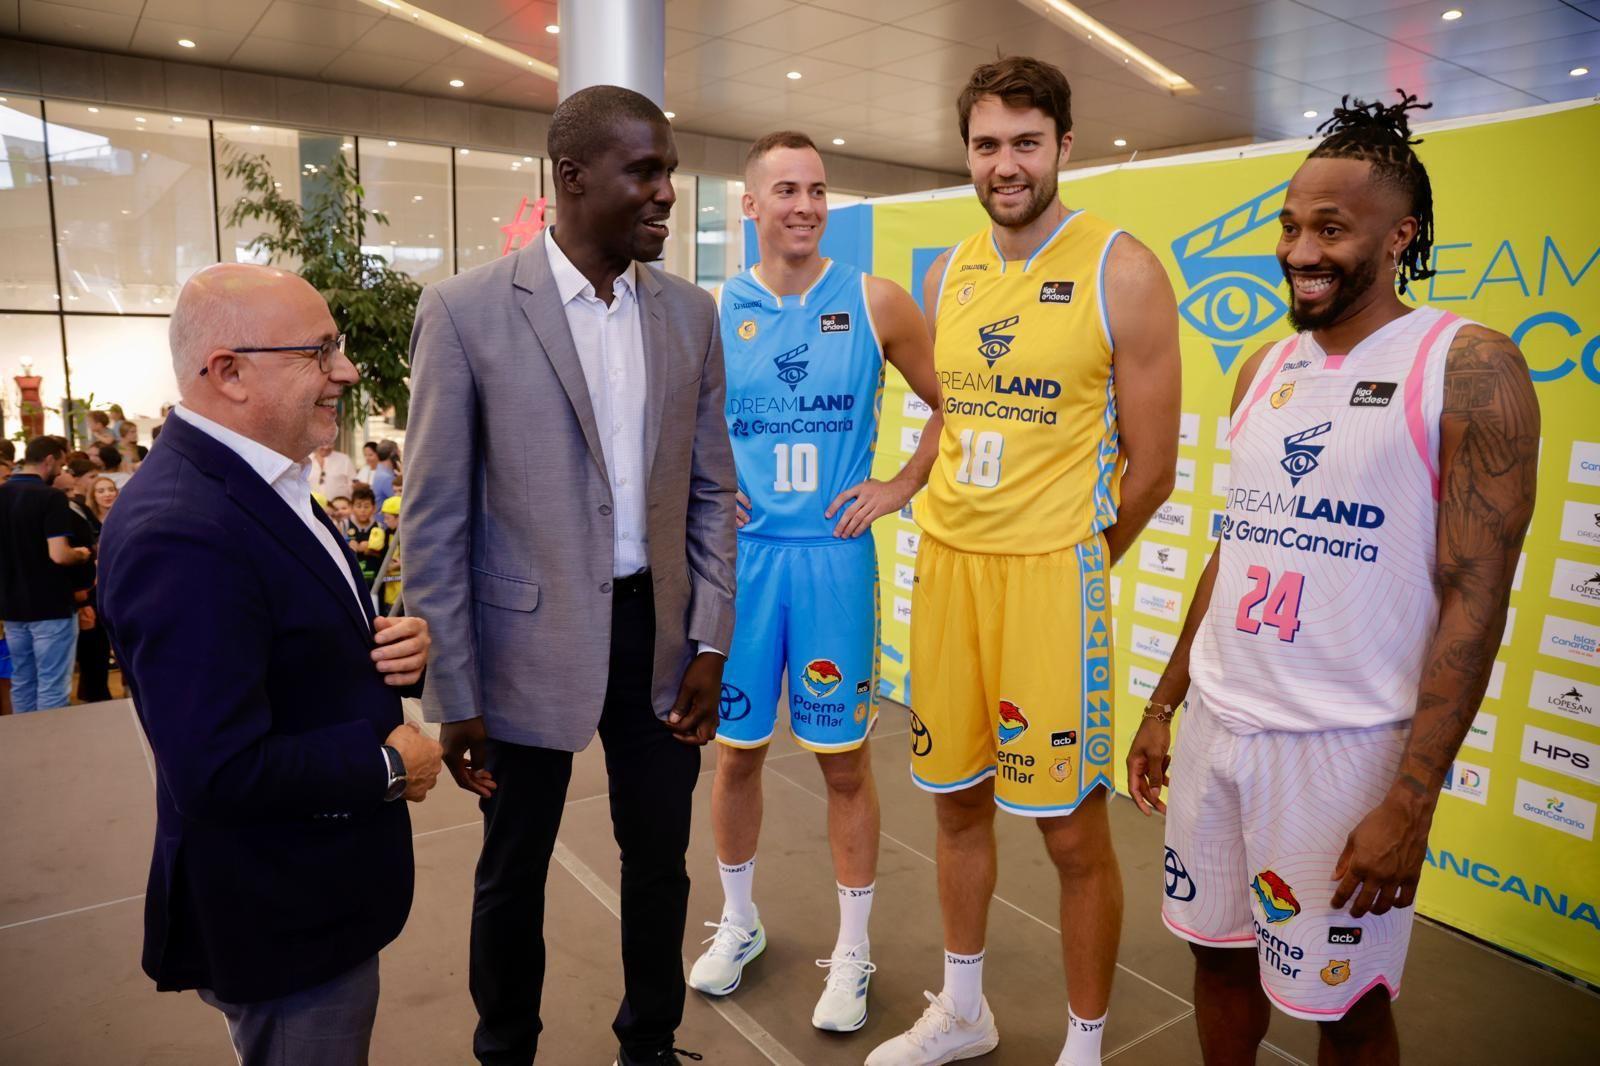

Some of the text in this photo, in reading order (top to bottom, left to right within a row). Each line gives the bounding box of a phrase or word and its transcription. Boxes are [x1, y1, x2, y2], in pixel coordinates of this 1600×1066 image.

[1041, 293, 1070, 302] endesa
[1043, 286, 1056, 295] liga
[1353, 395, 1389, 405] endesa
[1355, 387, 1373, 399] liga
[730, 394, 856, 415] DREAMLAND
[946, 396, 1058, 425] GranCanaria
[751, 418, 853, 435] GranCanaria
[773, 442, 819, 493] 10
[956, 428, 1005, 489] 18
[1235, 520, 1379, 563] GranCanaria
[1235, 564, 1306, 643] 24
[793, 694, 846, 714] Poema
[1547, 696, 1593, 715] LOPESAN
[793, 712, 844, 727] del Mar
[1053, 737, 1072, 746] acb
[1532, 740, 1590, 769] HPS
[1522, 803, 1586, 830] GranCanaria
[1331, 933, 1355, 944] acb
